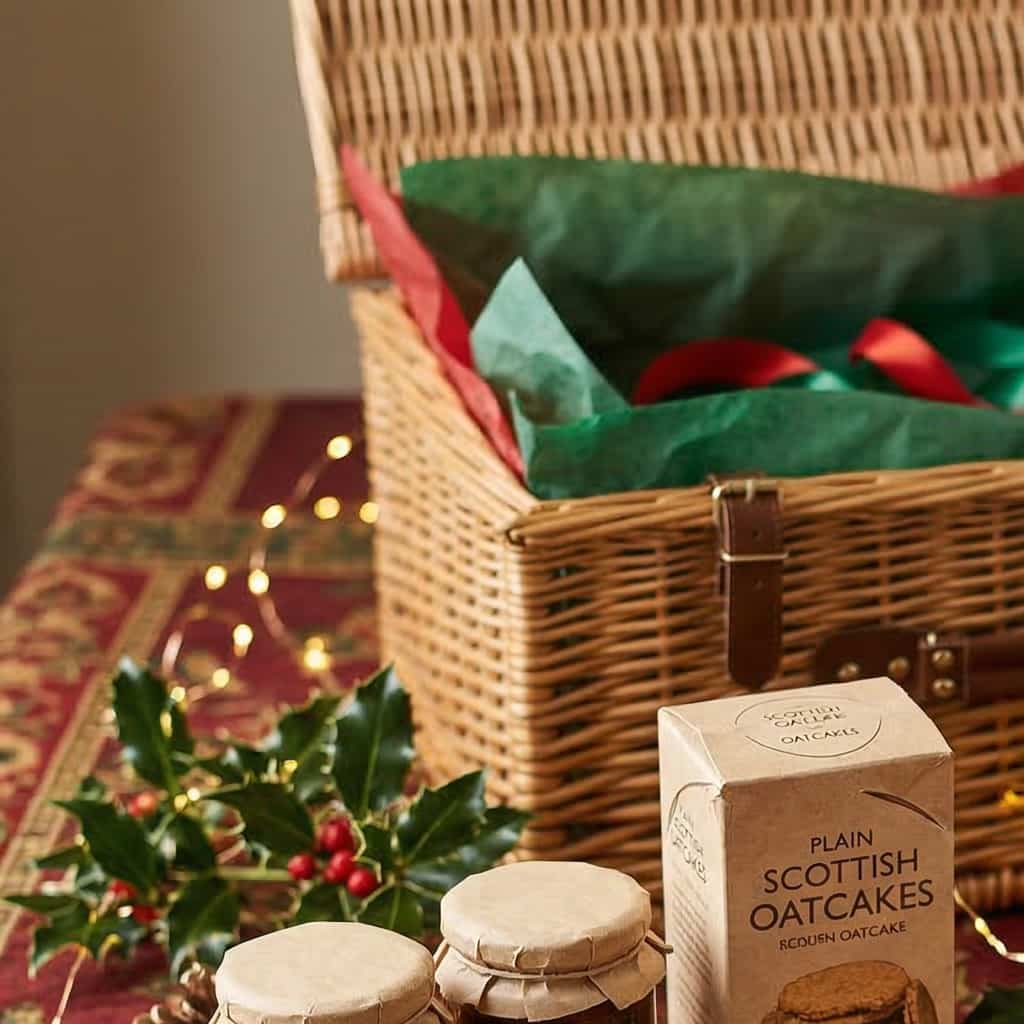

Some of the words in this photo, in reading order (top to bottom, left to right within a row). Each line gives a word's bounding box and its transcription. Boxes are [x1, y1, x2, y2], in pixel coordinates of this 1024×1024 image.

[810, 829, 873, 854] PLAIN
[763, 848, 918, 894] SCOTTISH
[750, 879, 934, 932] OATCAKES
[839, 920, 907, 942] OATCAKE
